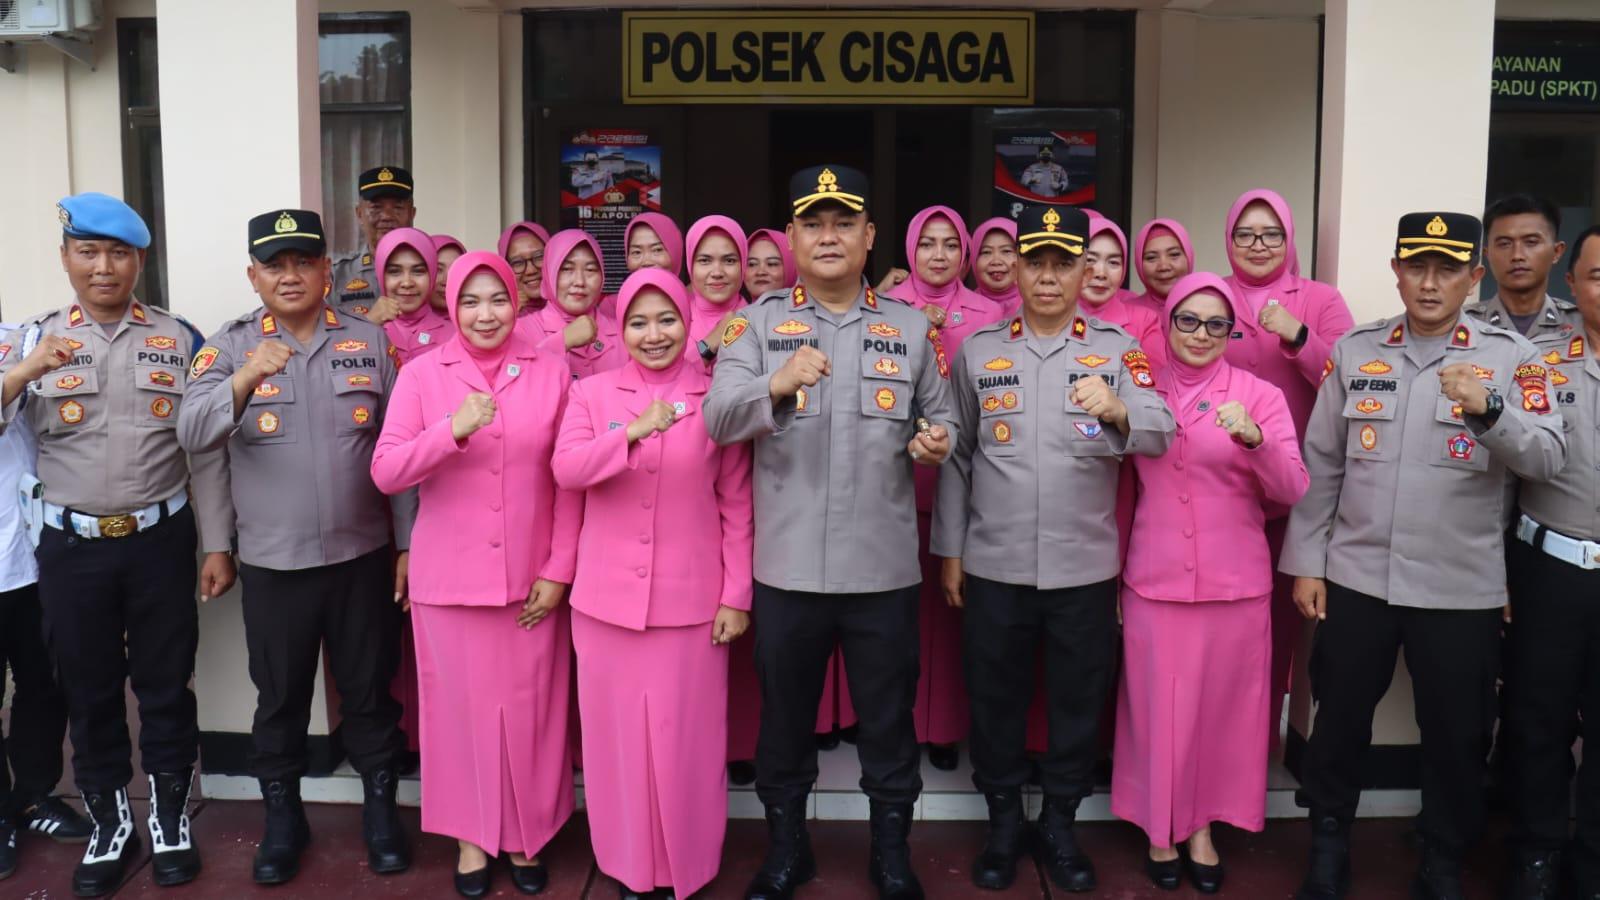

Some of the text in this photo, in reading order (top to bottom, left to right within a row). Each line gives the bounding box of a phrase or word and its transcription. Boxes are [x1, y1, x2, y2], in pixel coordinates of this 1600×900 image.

[642, 31, 1015, 83] POLSEK CISAGA
[1540, 80, 1598, 101] (SPKT)
[578, 205, 593, 219] 16
[863, 338, 907, 357] POLRI
[138, 351, 184, 367] POLRI
[331, 357, 376, 370] POLRI
[978, 373, 1019, 390] SUJANA
[1349, 379, 1368, 391] AEP
